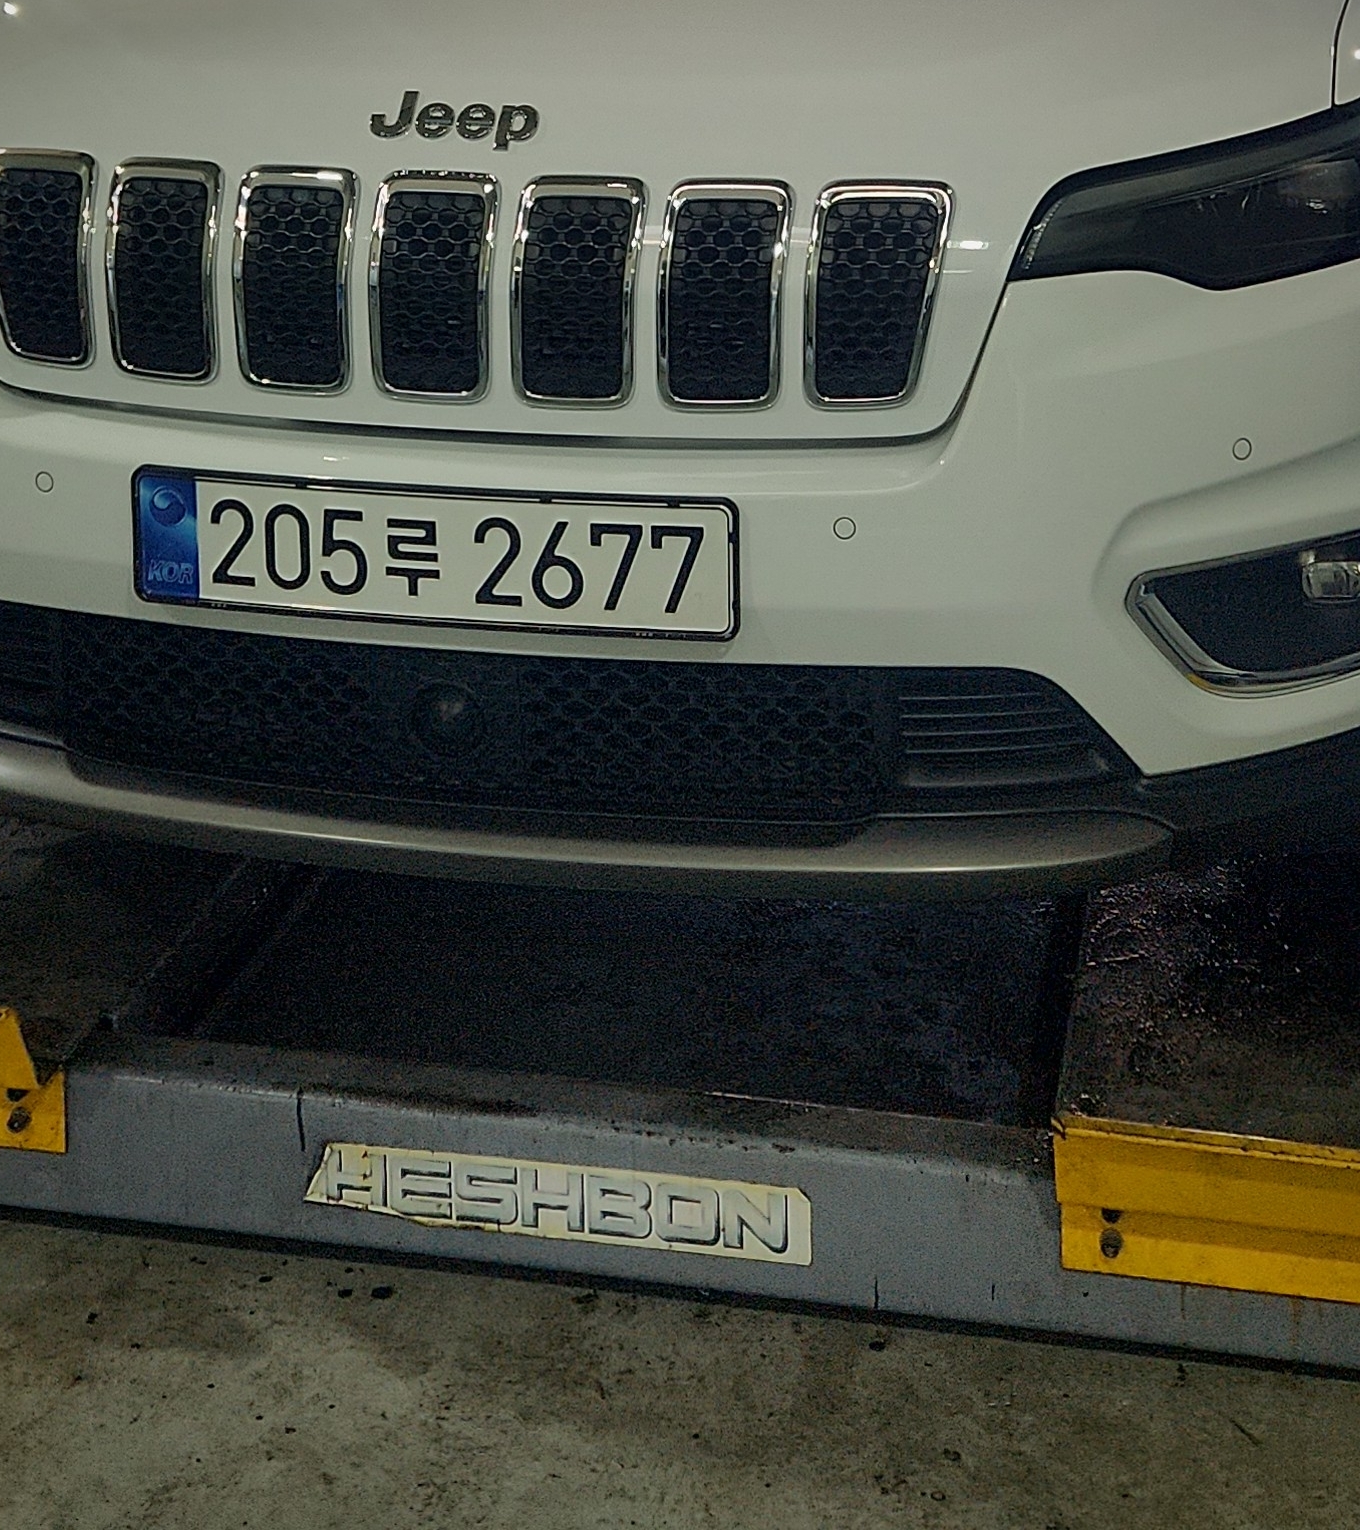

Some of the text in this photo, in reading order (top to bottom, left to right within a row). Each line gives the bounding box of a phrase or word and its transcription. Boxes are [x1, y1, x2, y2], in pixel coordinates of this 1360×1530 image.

[369, 90, 540, 152] Jeep
[148, 557, 195, 586] KOR
[208, 498, 706, 615] 205루 2677
[324, 1144, 791, 1256] HESHBON
